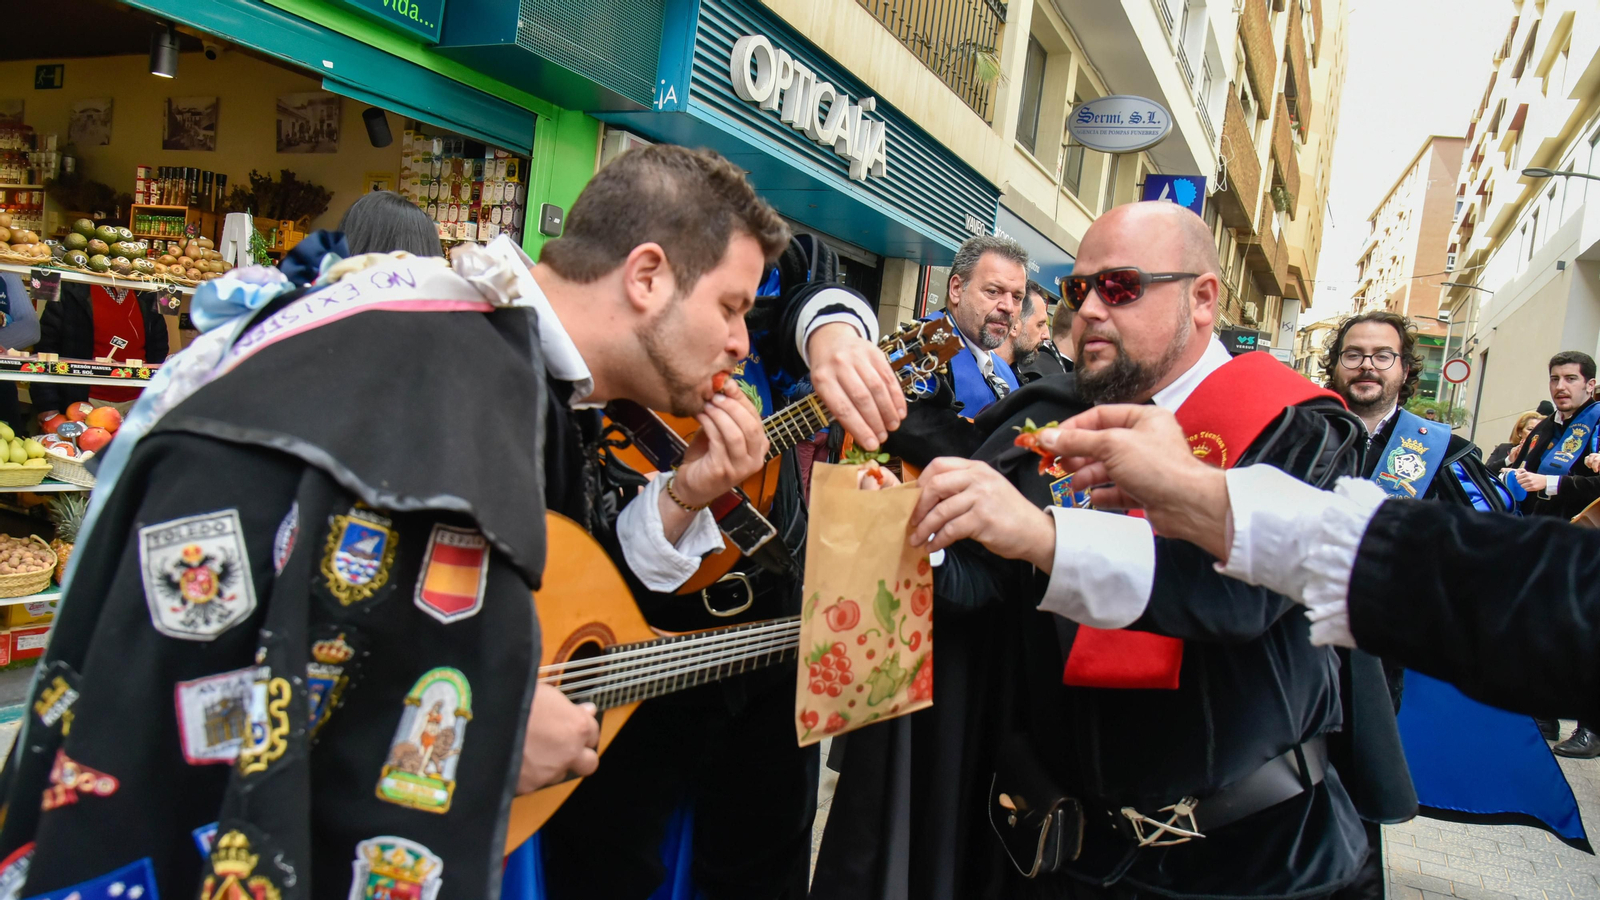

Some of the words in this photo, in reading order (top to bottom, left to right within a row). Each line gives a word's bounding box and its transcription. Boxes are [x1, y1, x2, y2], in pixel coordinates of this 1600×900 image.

[1077, 107, 1123, 124] Sermi,
[1128, 111, 1161, 124] S.L.
[371, 268, 416, 289] NO
[147, 520, 227, 546] TOLEDO
